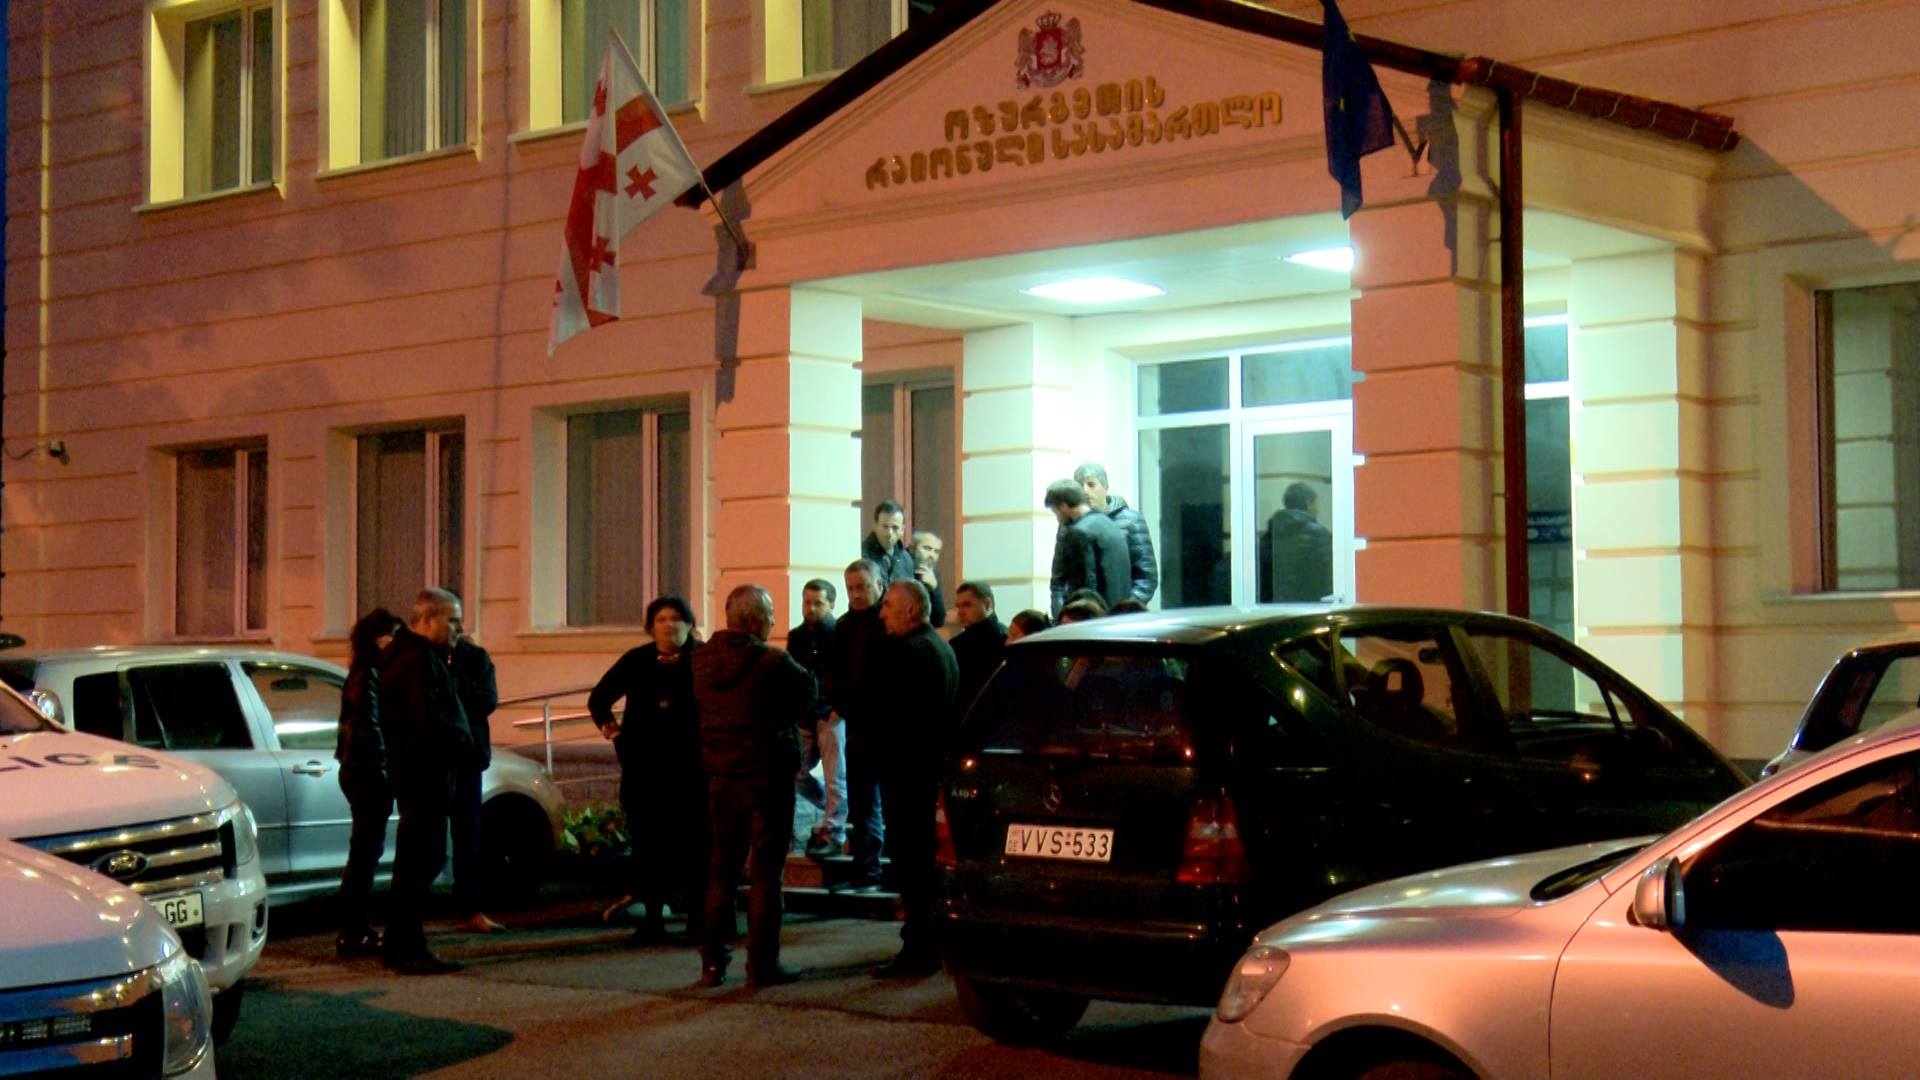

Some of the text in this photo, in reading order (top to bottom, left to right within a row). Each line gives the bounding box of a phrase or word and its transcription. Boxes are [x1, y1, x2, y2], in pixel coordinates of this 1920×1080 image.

[865, 91, 1283, 190] რაიონული სასამართლო
[945, 75, 1165, 141] ოზურგეთის
[1021, 829, 1109, 858] VVS-533
